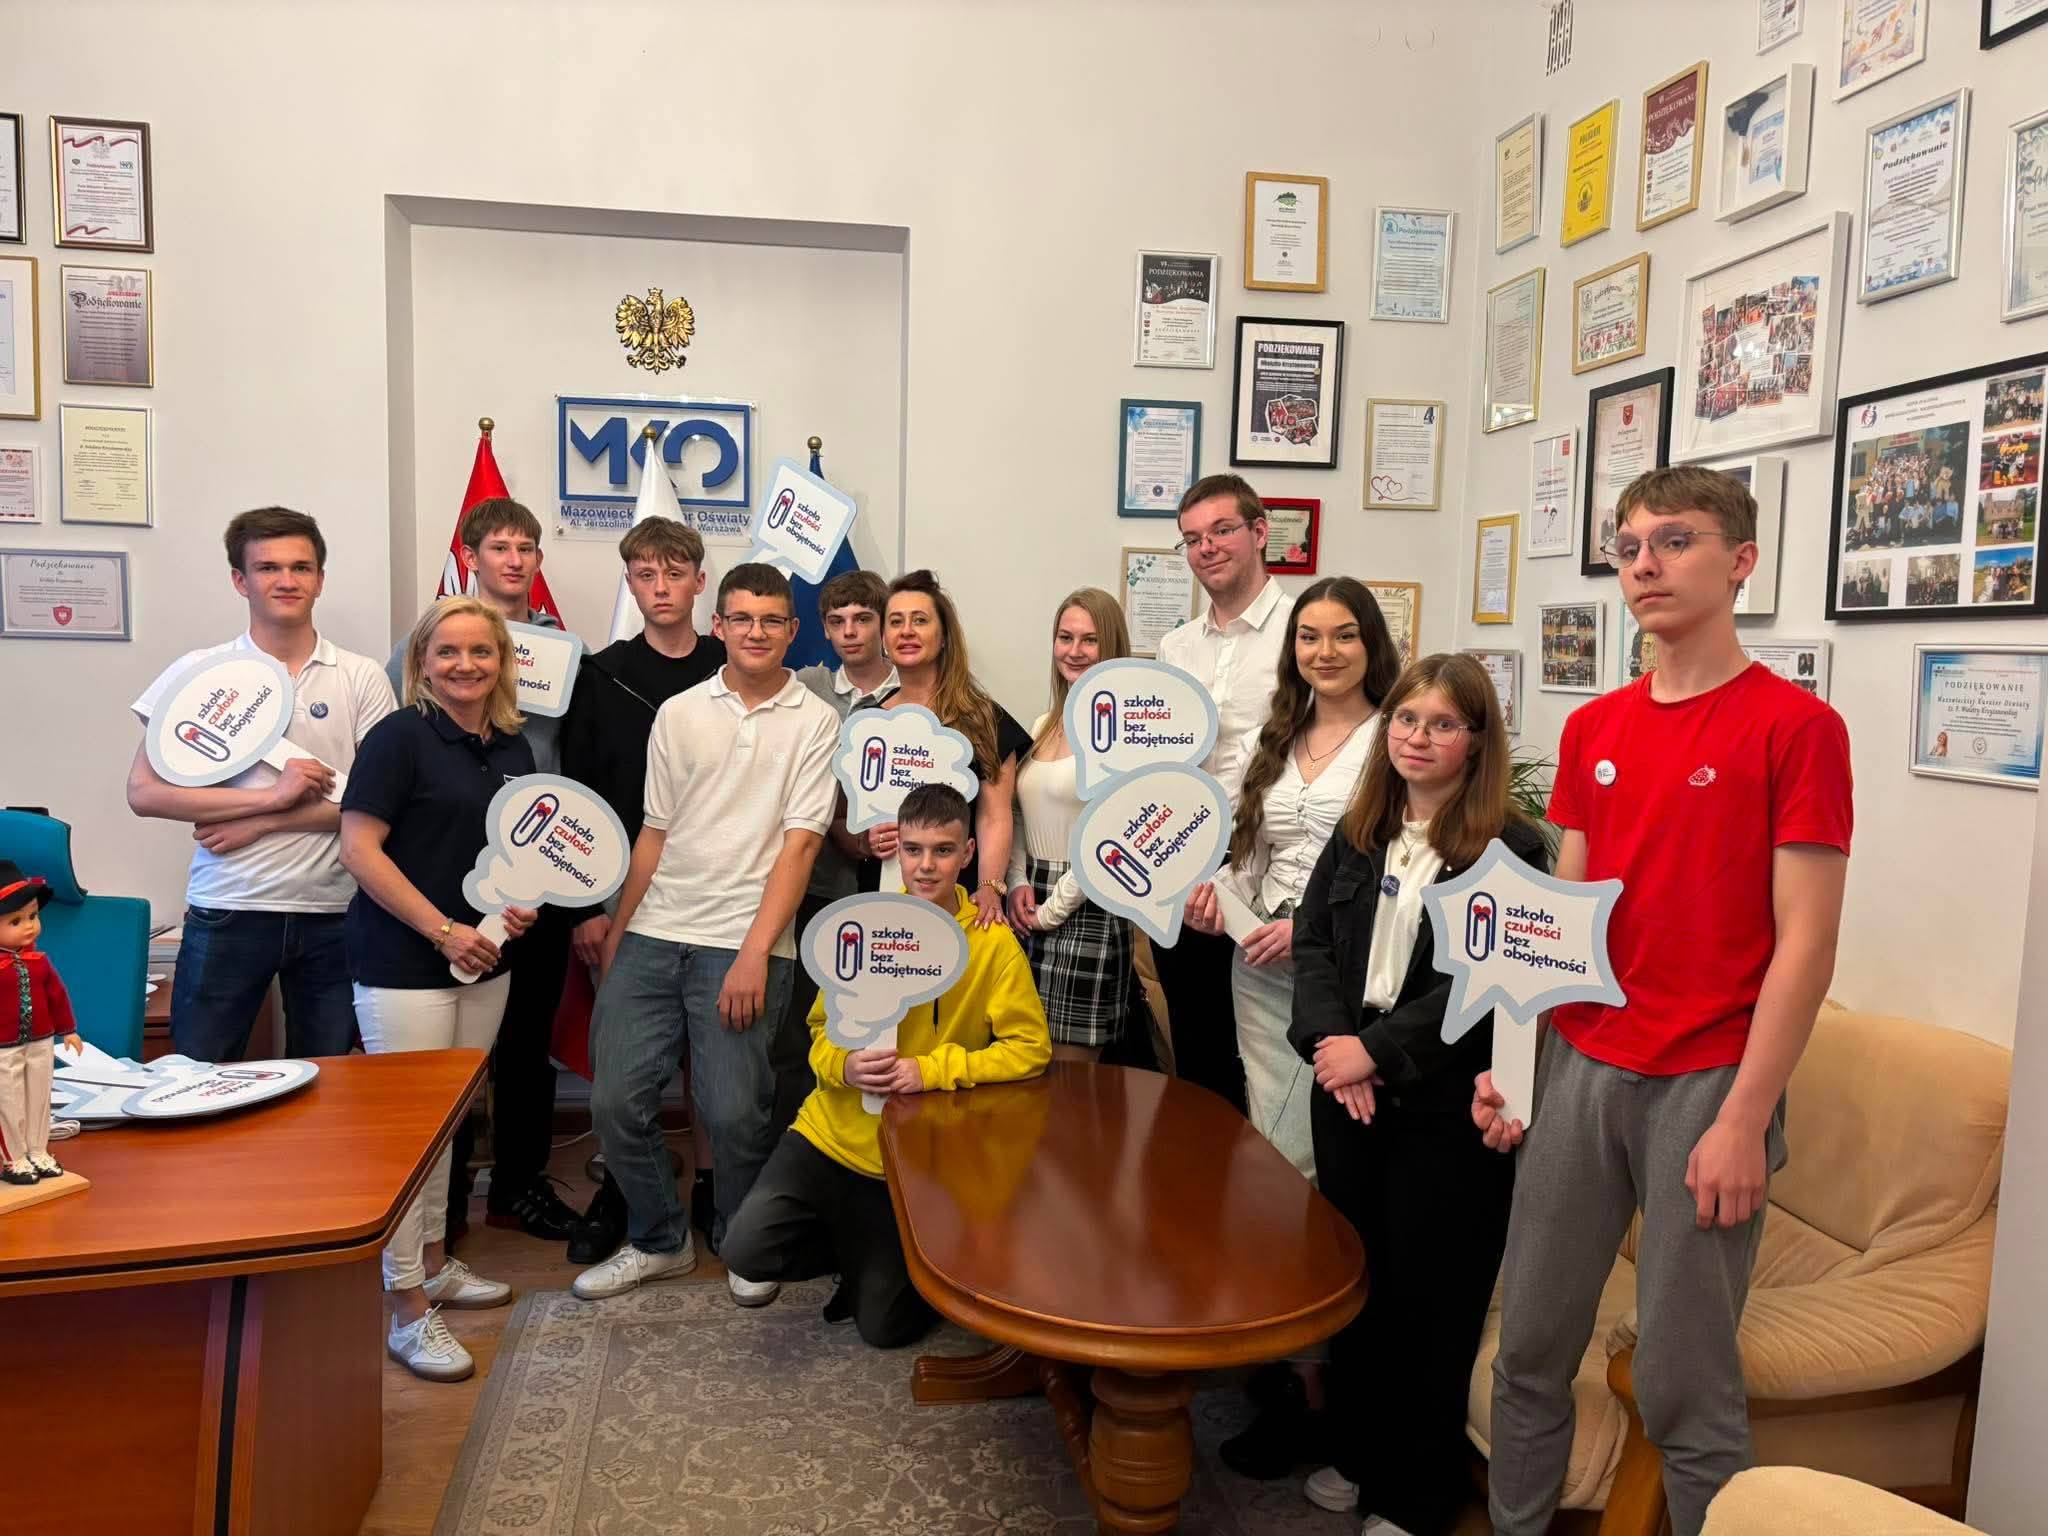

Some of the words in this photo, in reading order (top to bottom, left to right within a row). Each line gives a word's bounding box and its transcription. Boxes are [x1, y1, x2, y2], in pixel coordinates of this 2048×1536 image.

[560, 505, 634, 519] Mazowieck
[697, 510, 751, 526] Oświaty
[697, 523, 742, 534] Warszawa
[1944, 680, 2025, 692] PODZIĘKOWANIE
[197, 687, 226, 721] szkoła
[207, 687, 241, 725] czułości
[228, 684, 273, 738] obojętności
[1123, 695, 1165, 708] szkoła
[216, 713, 236, 732] bez
[1123, 707, 1172, 720] czułości
[1123, 720, 1147, 732] bez
[1123, 732, 1194, 748] obojętności
[892, 743, 930, 758] szkoła
[890, 765, 911, 777] bez
[891, 756, 935, 769] czułości
[889, 776, 945, 792] obojęt
[560, 814, 596, 844] szkoła
[1122, 802, 1159, 840] szkoła
[1132, 803, 1174, 850] czułości
[545, 831, 567, 853] bez
[552, 823, 595, 857] czułości
[1152, 804, 1212, 869] obojętności
[1139, 835, 1166, 860] bez
[538, 844, 598, 890] obojętności
[1505, 904, 1555, 925] szkoła
[871, 926, 914, 940] szkoła
[1503, 930, 1530, 948] bez
[1504, 919, 1562, 941] czułości
[870, 939, 921, 952] czułości
[870, 950, 894, 963] bez
[1502, 947, 1588, 975] obojętności
[869, 963, 942, 979] obojętności
